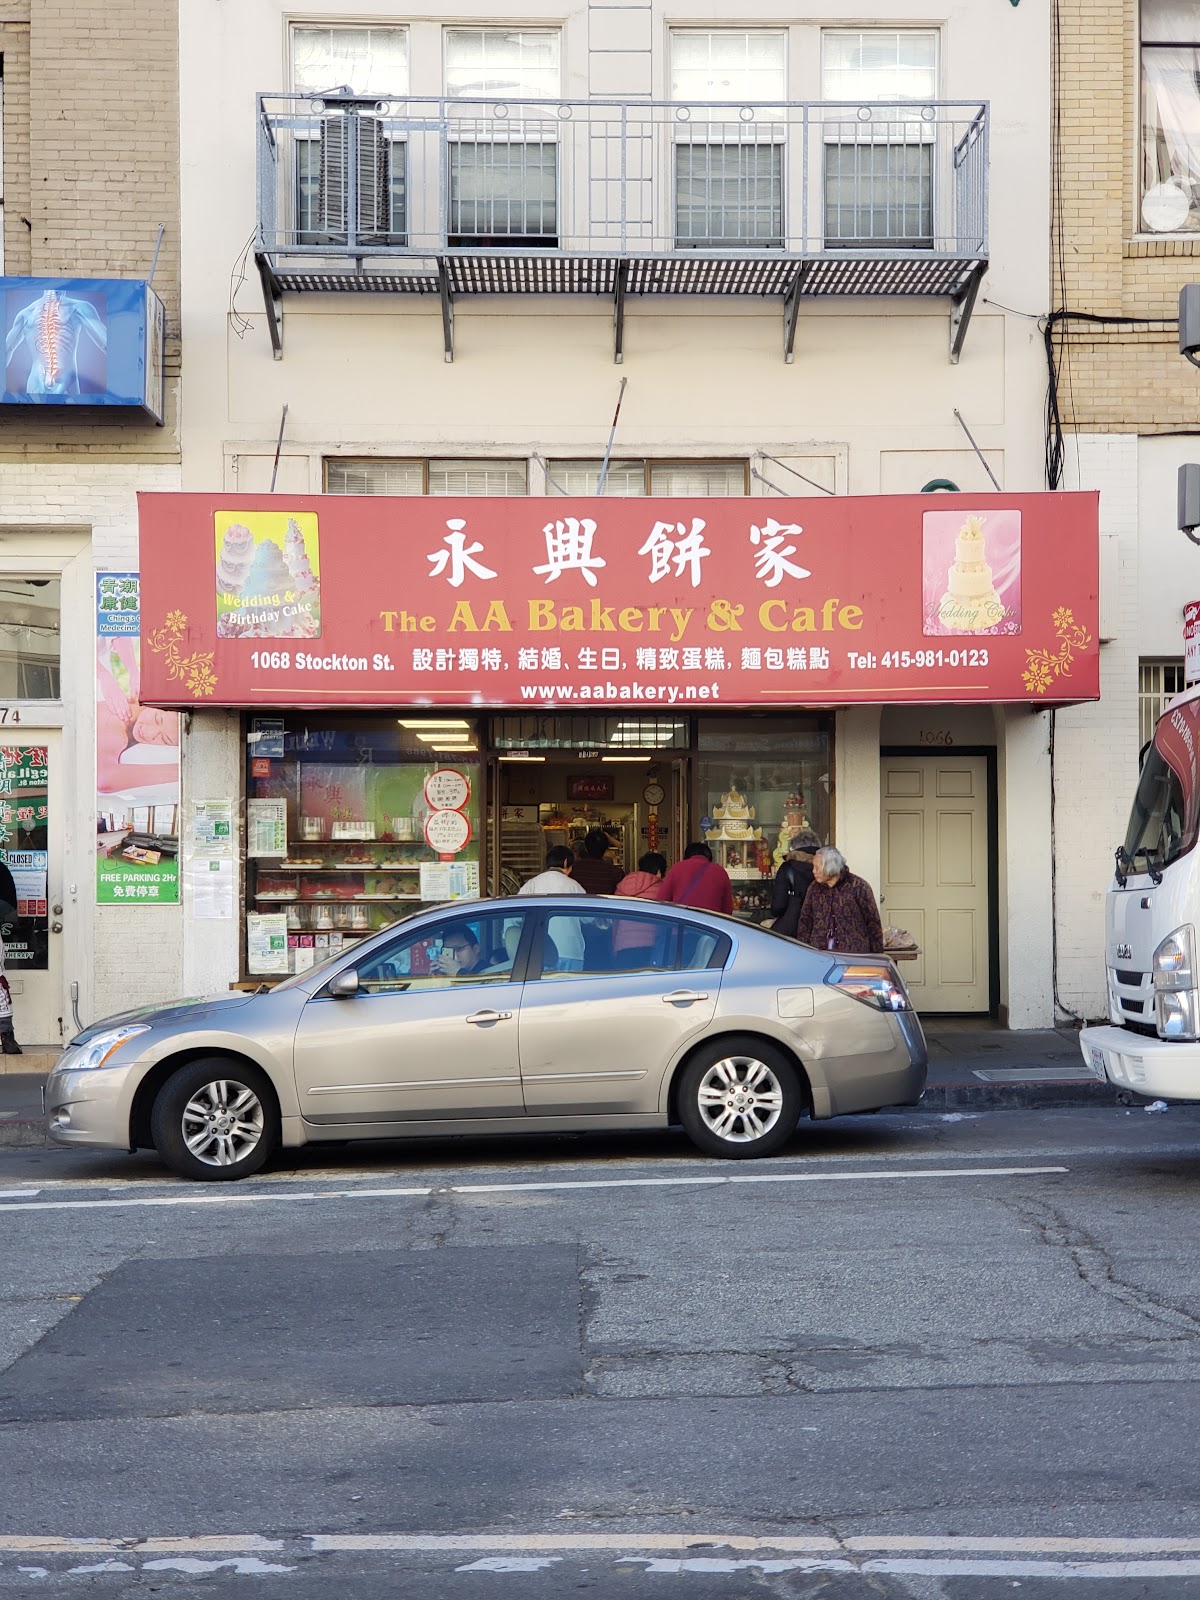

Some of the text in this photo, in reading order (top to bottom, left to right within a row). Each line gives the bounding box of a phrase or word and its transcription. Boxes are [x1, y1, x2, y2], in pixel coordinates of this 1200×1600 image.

[427, 517, 812, 588] 永興餅家
[100, 578, 140, 594] 青潮
[222, 590, 296, 609] Wedding &
[107, 614, 135, 624] Ching's
[228, 602, 313, 626] Birthday Cake
[380, 597, 863, 643] The AA Bakery & Cafe
[926, 599, 1018, 625] Wedding Cake
[100, 624, 136, 632] Medecine
[250, 651, 395, 671] 1068 Stockton St.
[847, 649, 990, 670] Tel: 415-981-0123
[520, 682, 721, 704] www.aabakery.net
[919, 730, 954, 746] 1066
[9, 853, 33, 864] CLOSED
[100, 873, 177, 882] FREE PARKING 2Hr
[113, 885, 160, 898] 免費停車
